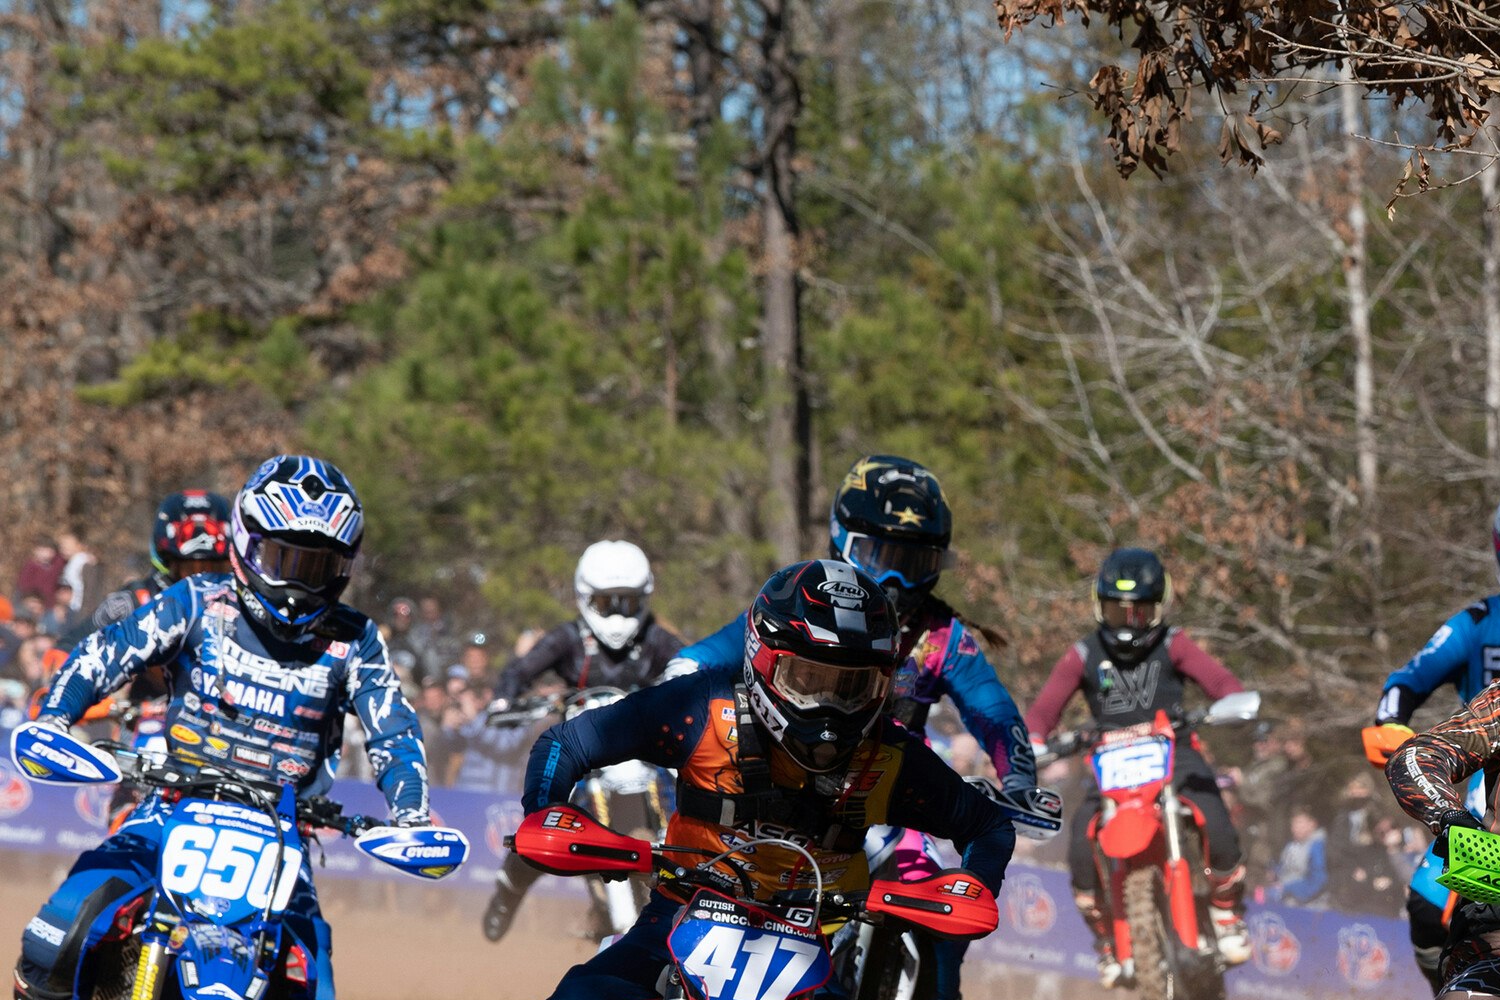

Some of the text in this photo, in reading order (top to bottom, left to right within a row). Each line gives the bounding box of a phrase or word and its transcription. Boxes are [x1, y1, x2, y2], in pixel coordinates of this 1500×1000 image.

[829, 580, 867, 597] Arai
[203, 672, 286, 718] YAMAHA
[752, 692, 784, 734] 417
[31, 741, 76, 769] CYCRA
[406, 845, 451, 859] CYCRA
[161, 824, 303, 912] 650
[698, 899, 736, 912] GUTISH
